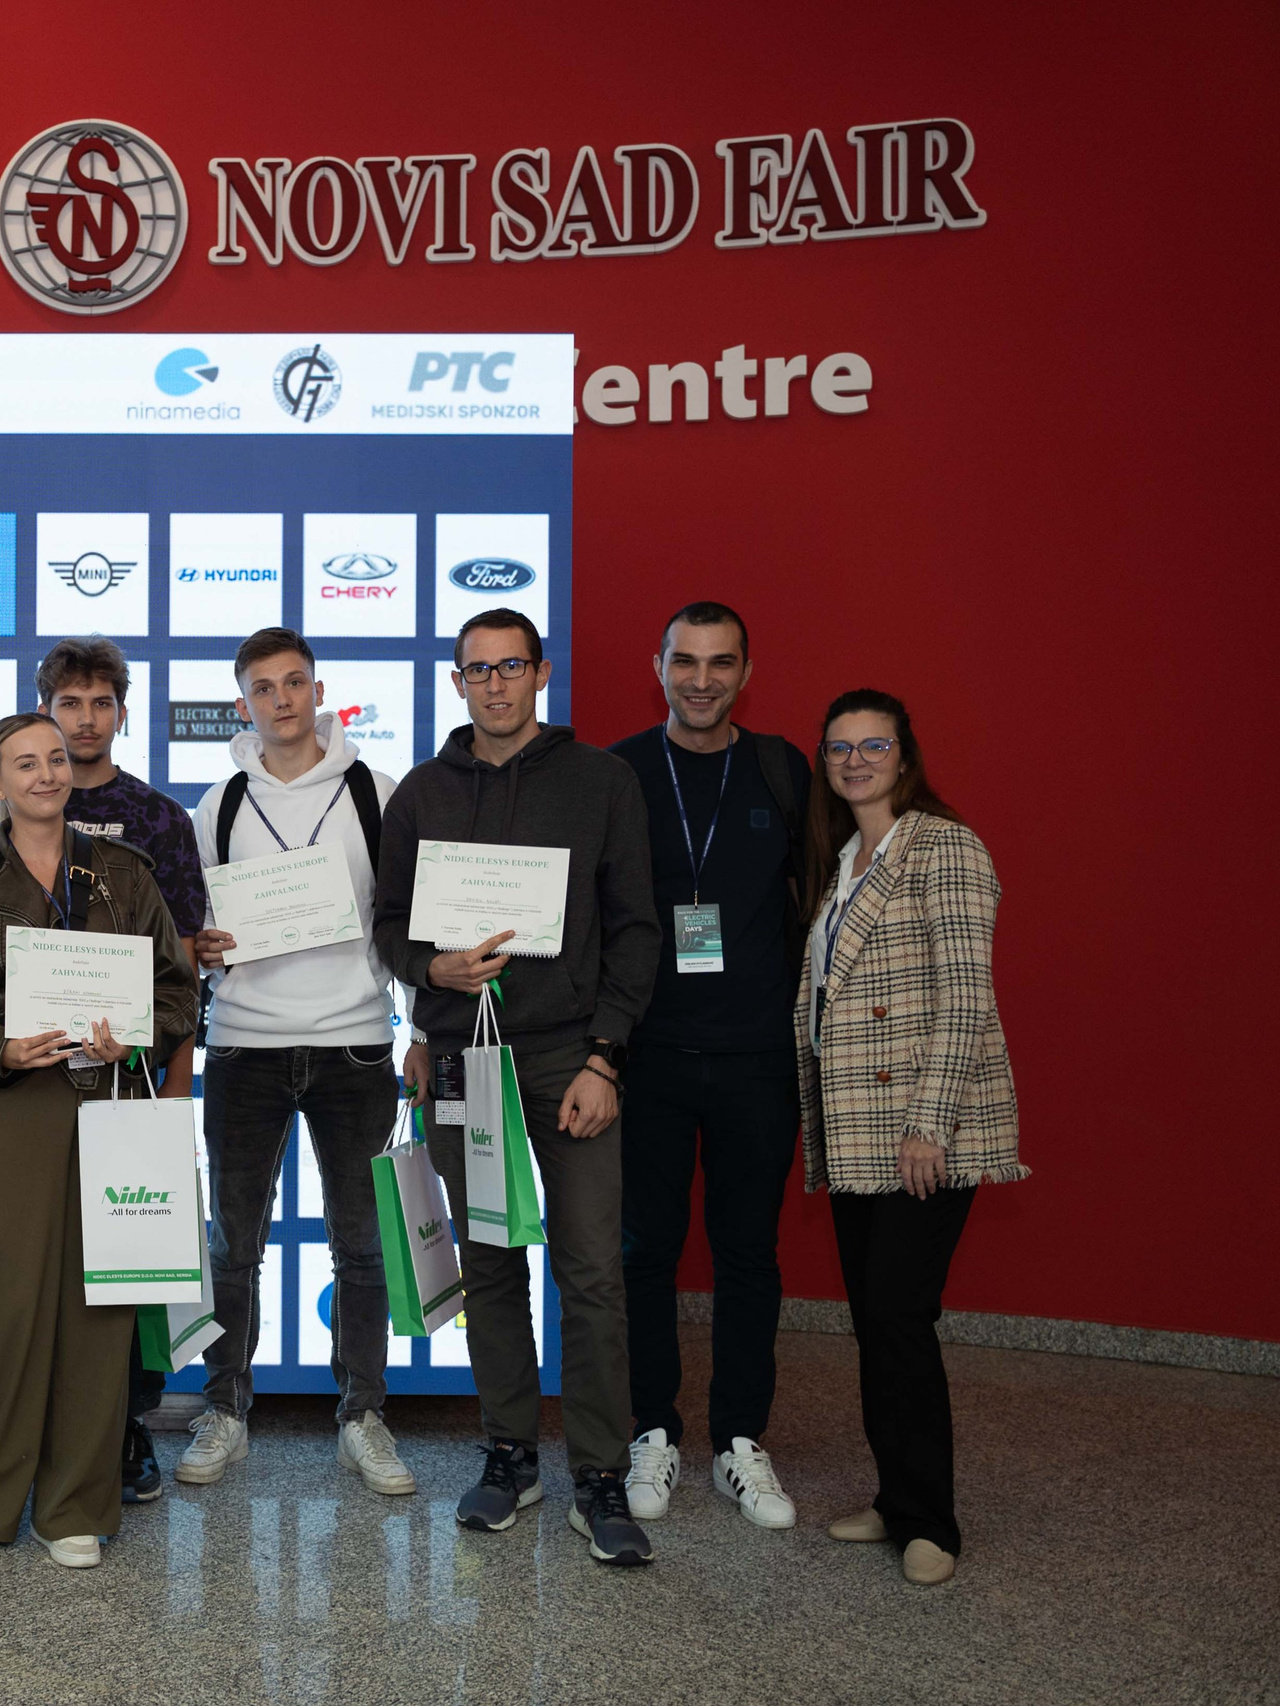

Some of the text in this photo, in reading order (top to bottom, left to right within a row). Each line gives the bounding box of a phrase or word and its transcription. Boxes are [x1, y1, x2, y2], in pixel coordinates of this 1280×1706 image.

[208, 117, 987, 266] NOVI SAD FAIR
[573, 343, 872, 427] entre
[127, 404, 241, 421] ninamedia
[371, 404, 540, 419] MEDIJSKI SPONZOR
[77, 568, 108, 581] MINI
[204, 569, 278, 582] HYUNDAI
[465, 562, 519, 589] Ford
[321, 586, 398, 600] CHERY
[174, 722, 187, 735] BY
[444, 854, 550, 869] NIDEC ELESYS EUROPE
[231, 871, 260, 883] NIDEC
[261, 864, 293, 877] ELESYS
[294, 856, 329, 870] EUROPE
[254, 882, 310, 900] ZAHVALNICU
[461, 878, 522, 889] ZAHVALNICU
[32, 942, 135, 957] NIDEC ELESYS EUROPE
[52, 968, 110, 979] ZAHVALNICU
[471, 1127, 494, 1146] Nidec
[102, 1186, 177, 1204] Nidec
[109, 1208, 171, 1216] All for dreams
